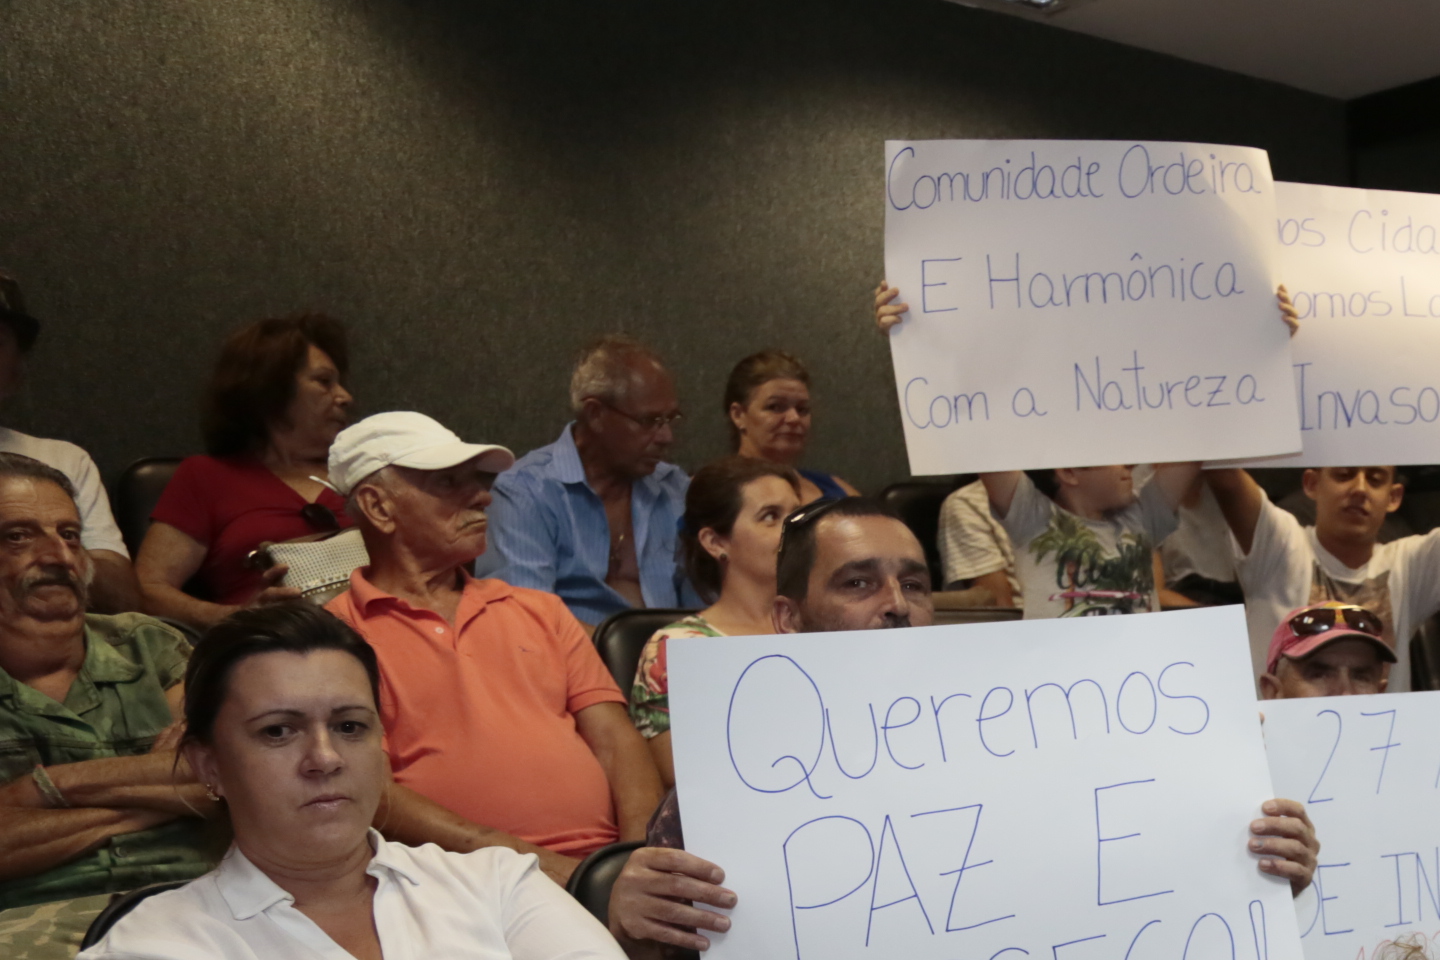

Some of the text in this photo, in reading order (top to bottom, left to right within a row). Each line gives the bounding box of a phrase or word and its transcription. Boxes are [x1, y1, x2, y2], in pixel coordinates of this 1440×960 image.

[888, 144, 1262, 210] Comunidade Ordeira
[1277, 217, 1326, 247] os
[922, 252, 1245, 314] E Harmônica
[904, 349, 1266, 430] Com a Natureza
[727, 654, 1210, 799] Queremos
[1307, 708, 1401, 804] 27
[783, 778, 1175, 960] PAZ E
